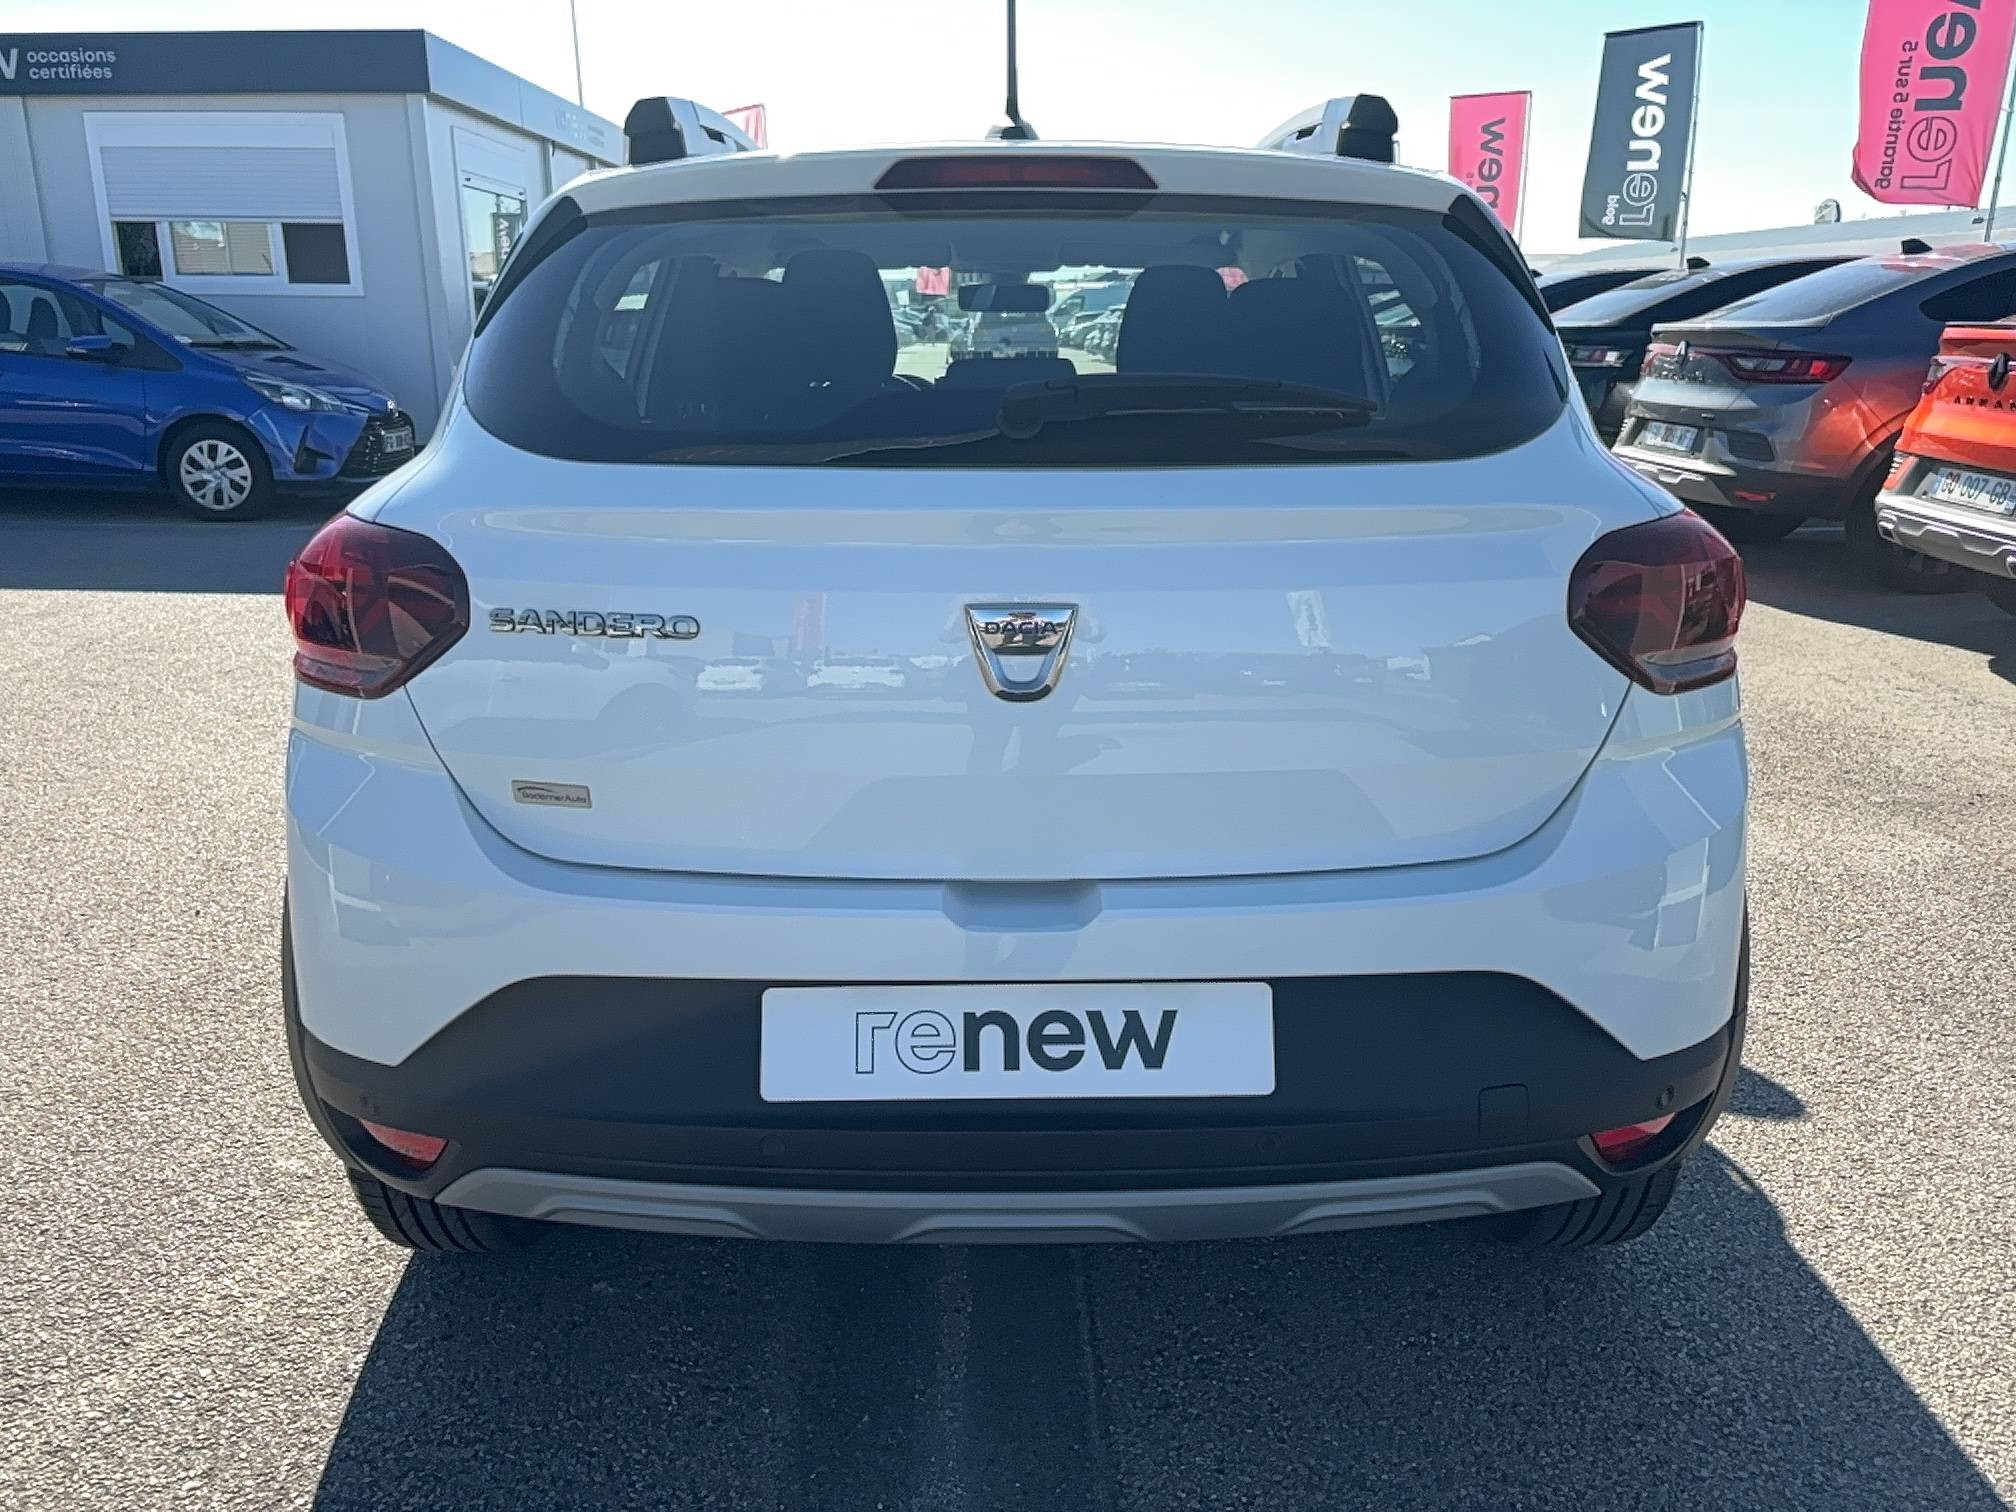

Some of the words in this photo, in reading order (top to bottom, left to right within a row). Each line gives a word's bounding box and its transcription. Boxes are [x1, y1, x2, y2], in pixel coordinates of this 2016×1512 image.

[26, 47, 117, 63] occasions
[28, 63, 113, 79] certifiées
[489, 607, 701, 640] SANDERO
[985, 621, 1058, 635] DACIA
[855, 1009, 1178, 1074] renew
